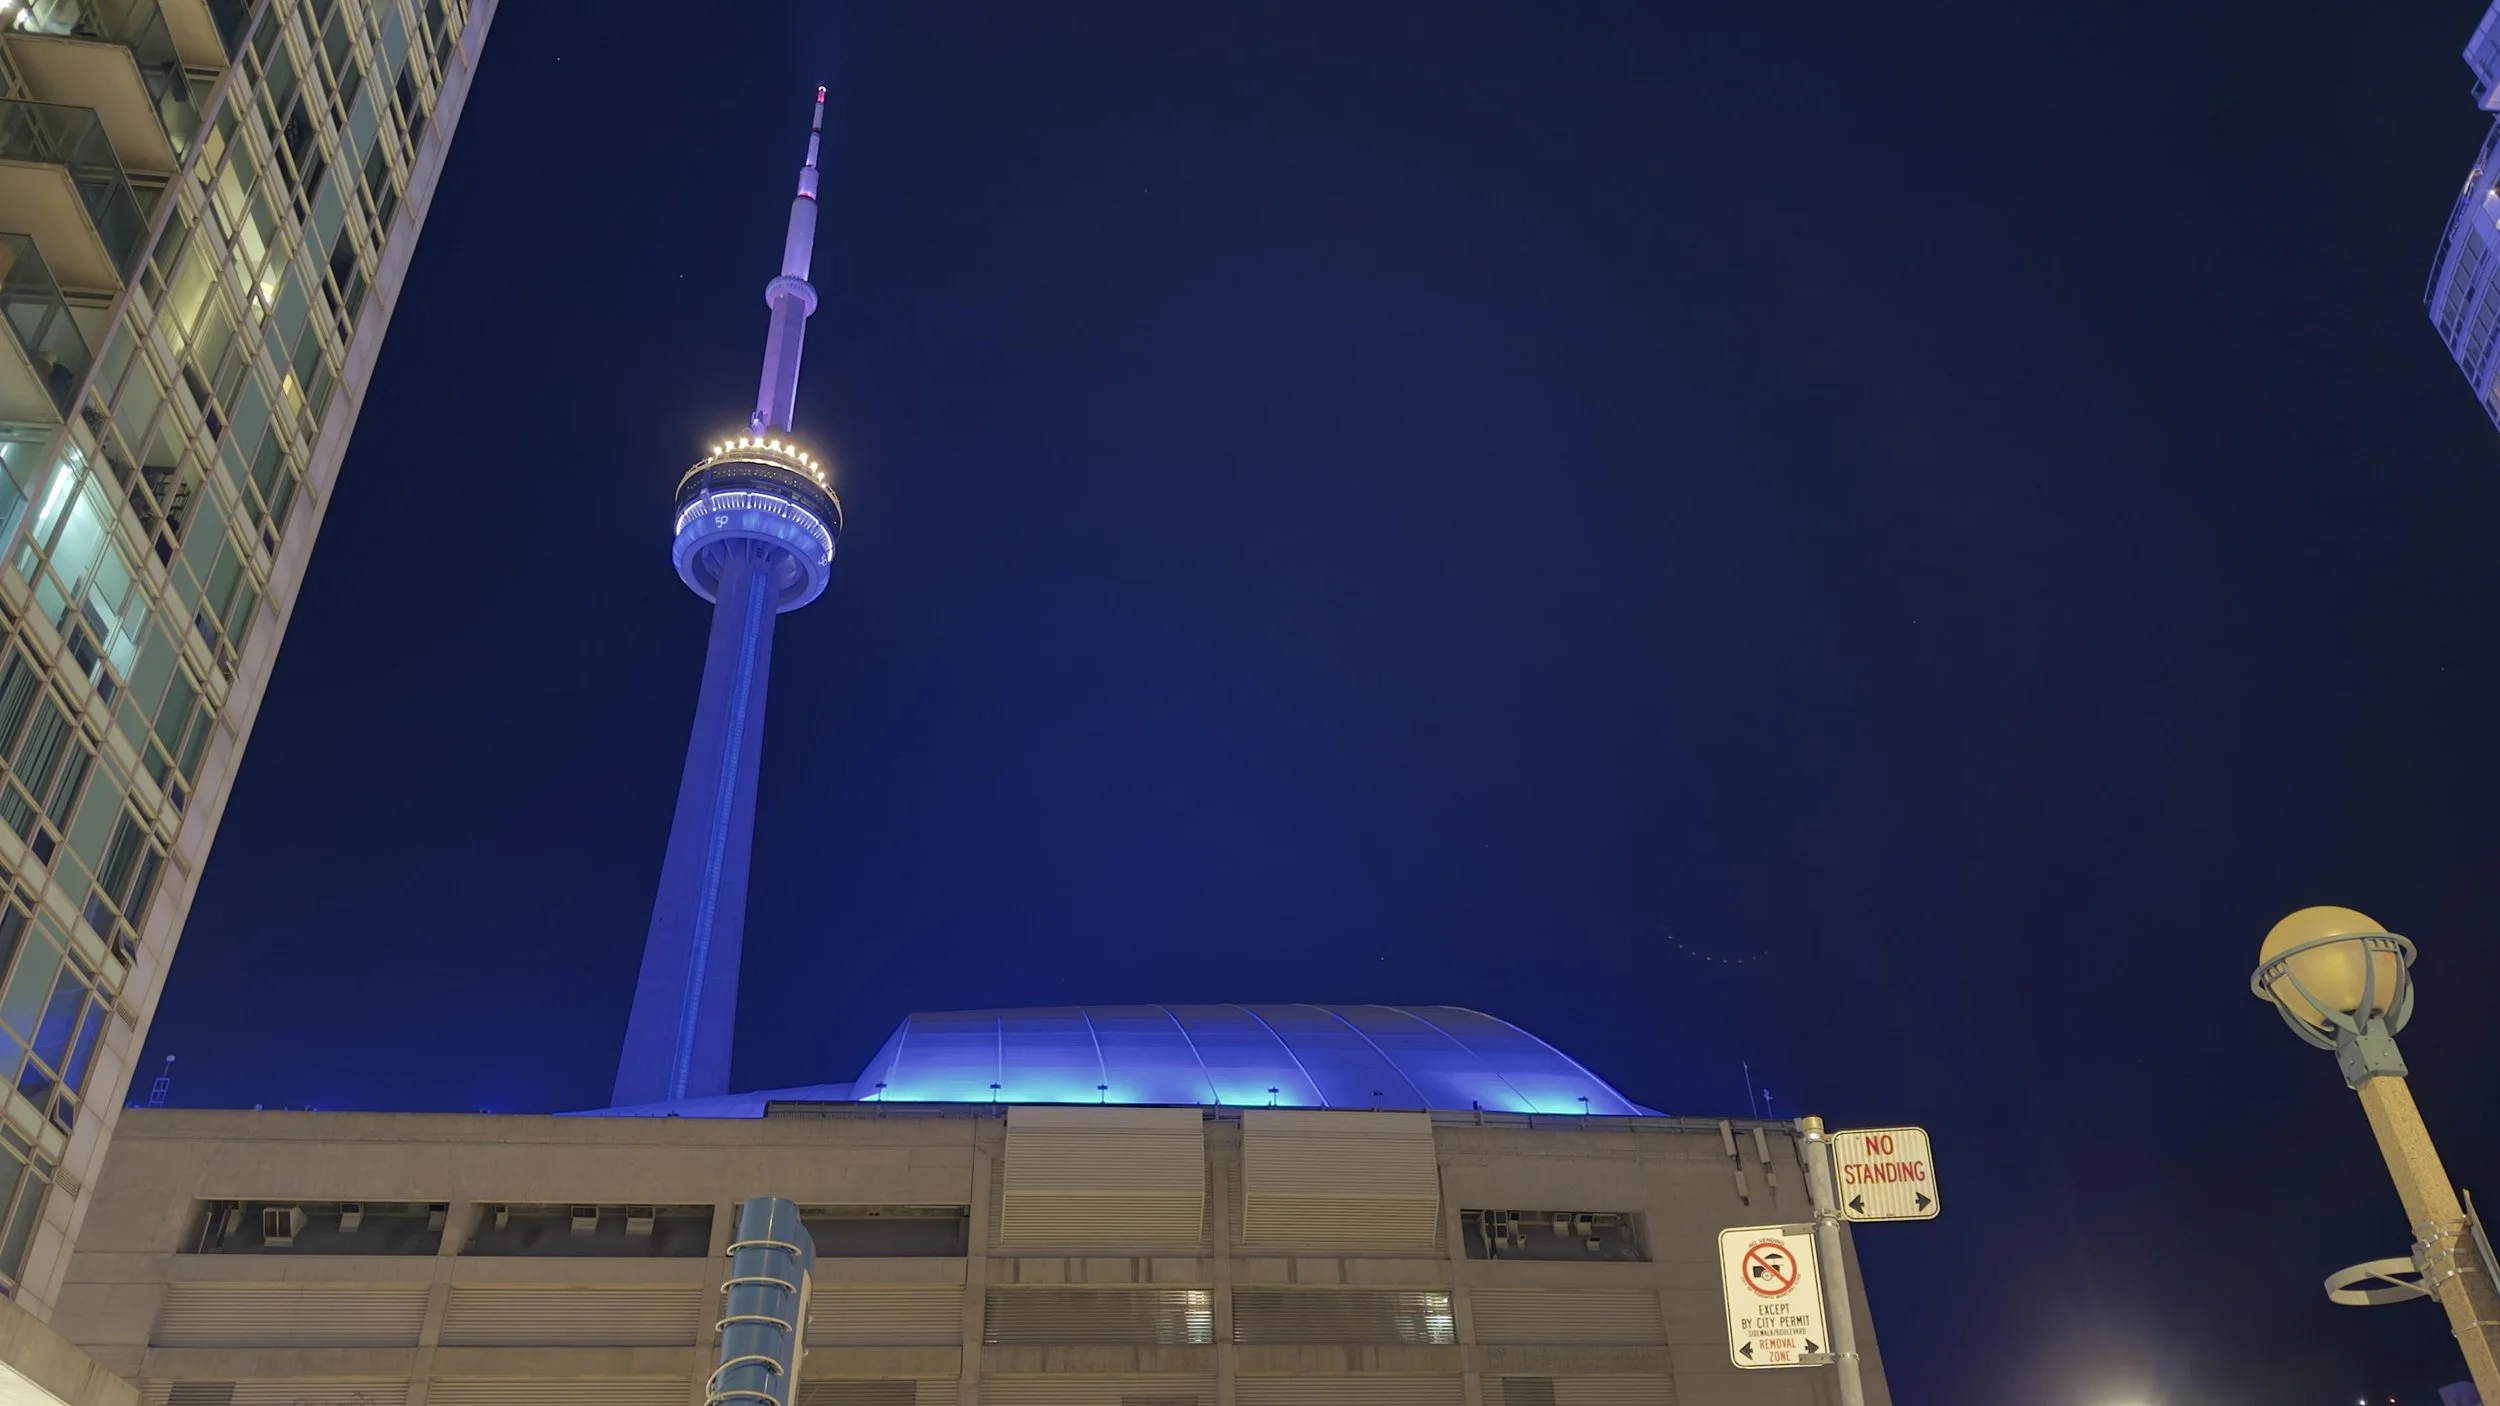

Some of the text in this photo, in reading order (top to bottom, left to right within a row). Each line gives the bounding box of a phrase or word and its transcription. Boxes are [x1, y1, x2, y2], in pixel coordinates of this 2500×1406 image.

[1865, 1134, 1894, 1156] NO
[1844, 1160, 1926, 1185] STANDING
[1758, 1238, 1785, 1246] VENDING
[1759, 1303, 1790, 1316] EXCEPT
[1741, 1315, 1810, 1329] BY CITY PERMIT
[1759, 1338, 1797, 1350] REMOVAL
[1769, 1351, 1791, 1362] ZONE
